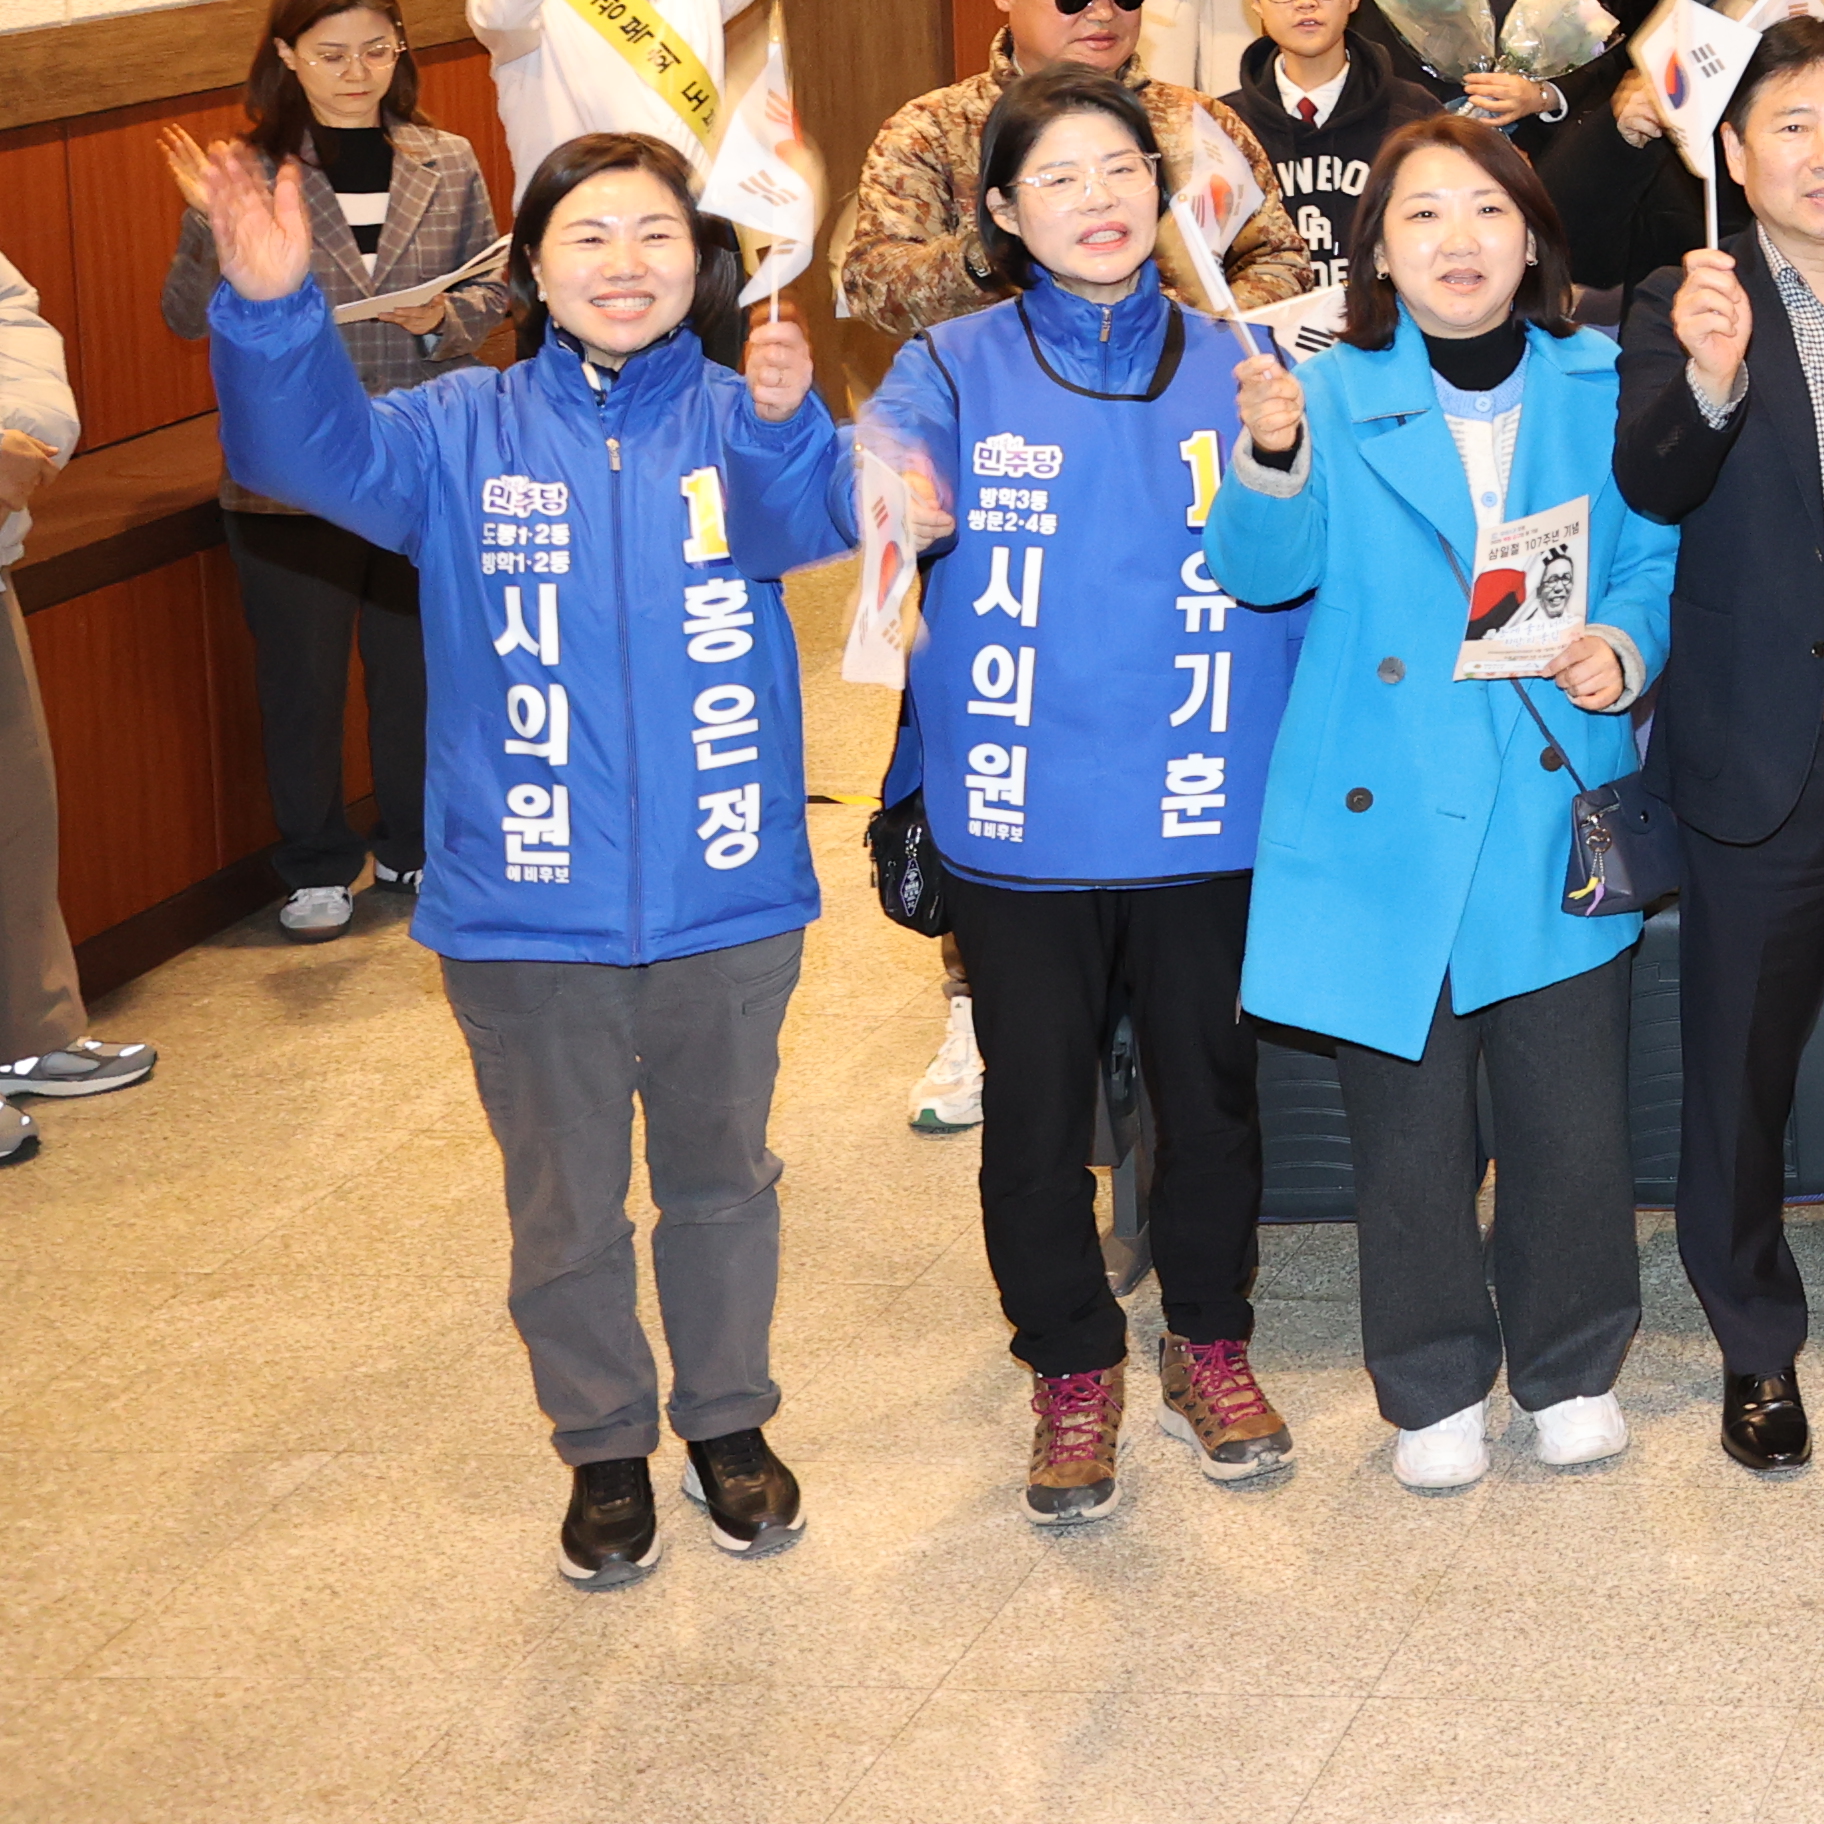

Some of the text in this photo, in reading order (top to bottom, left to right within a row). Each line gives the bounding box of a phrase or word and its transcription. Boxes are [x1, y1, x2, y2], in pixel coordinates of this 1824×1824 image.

[493, 582, 571, 866] 시의원
[682, 577, 762, 870] 홍은정
[964, 546, 1044, 825] 시의원
[1160, 549, 1237, 838] 유기훈
